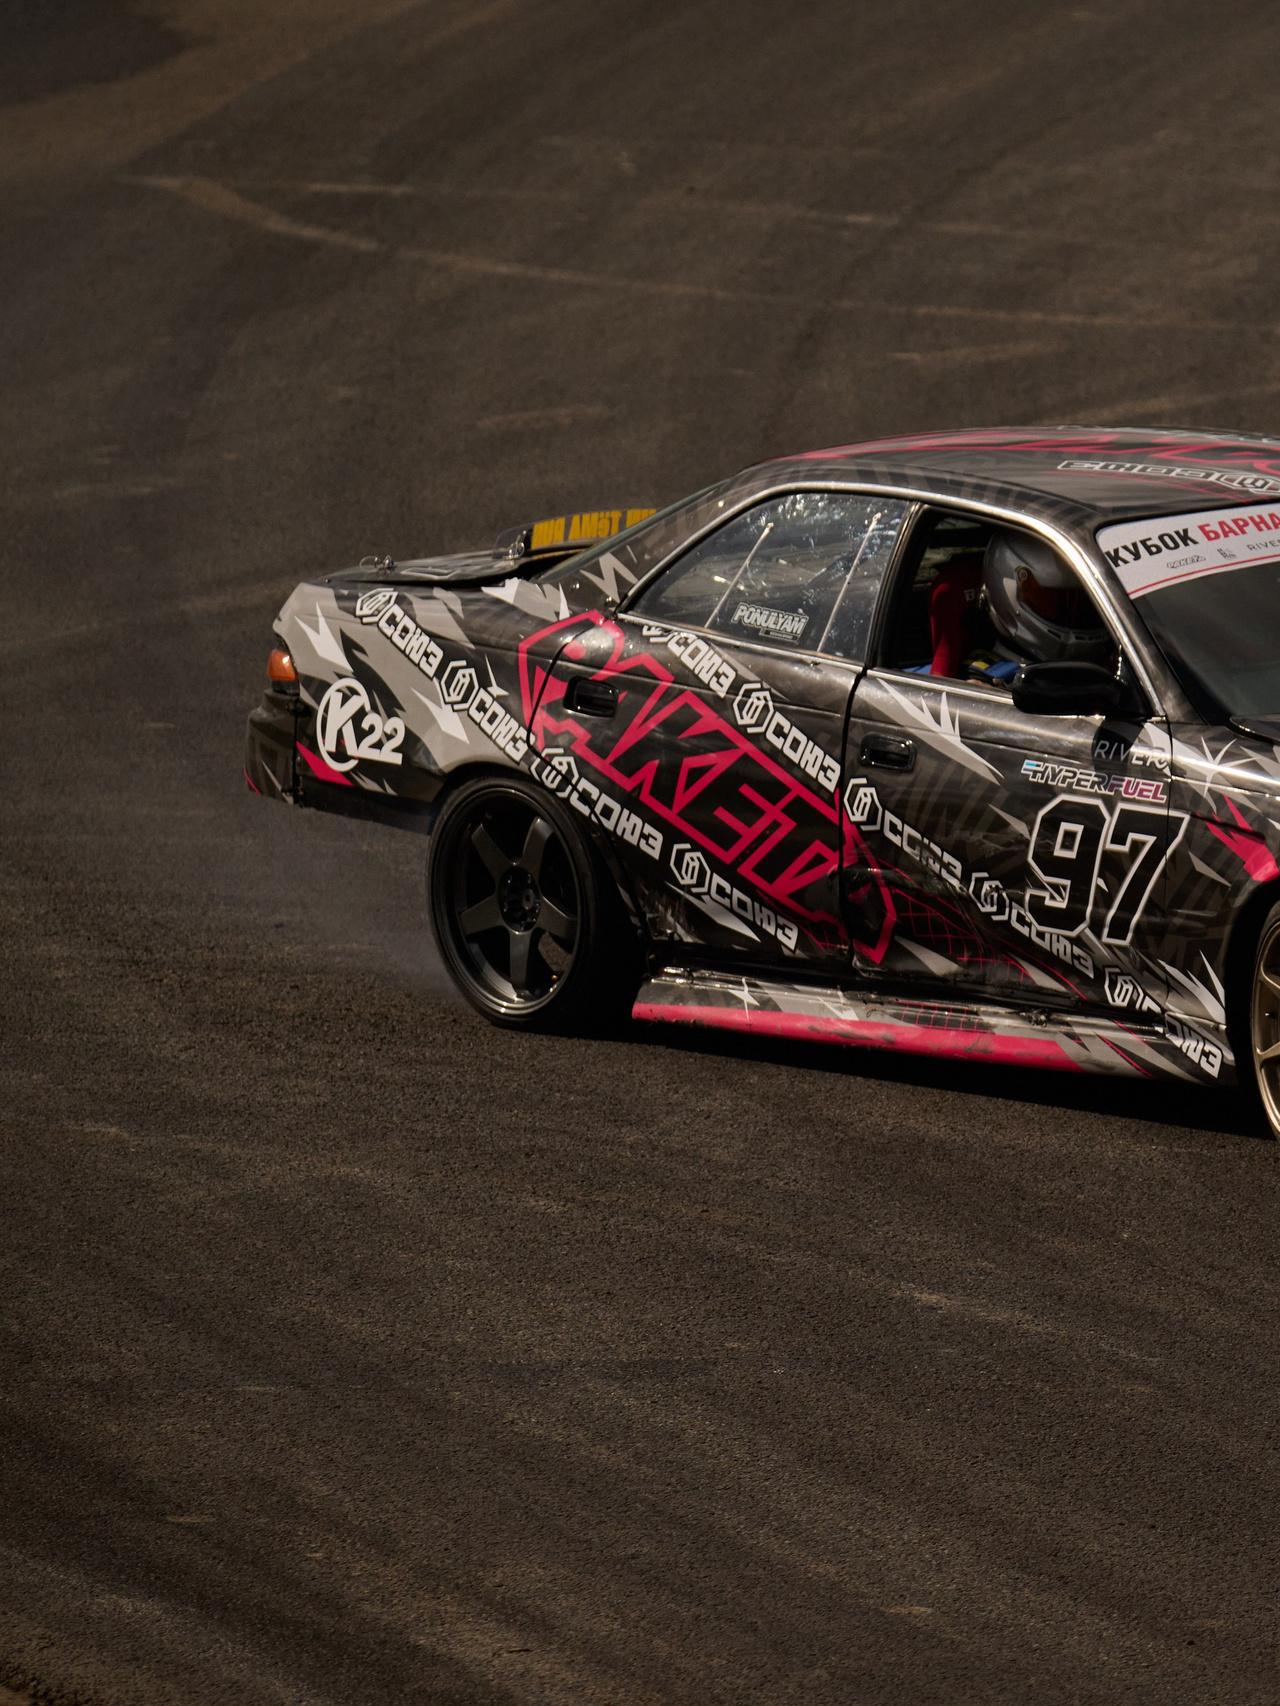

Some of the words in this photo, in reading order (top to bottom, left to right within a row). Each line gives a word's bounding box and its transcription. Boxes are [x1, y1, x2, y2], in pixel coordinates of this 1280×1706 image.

[1105, 528, 1199, 567] КУБОК
[378, 606, 443, 681] СОЮЗ
[734, 605, 807, 634] PONULYAM
[667, 632, 737, 698] СОЮЗ
[766, 720, 841, 793] СОЮЗ
[1094, 740, 1168, 769] RIVER
[1025, 794, 1189, 946] 97
